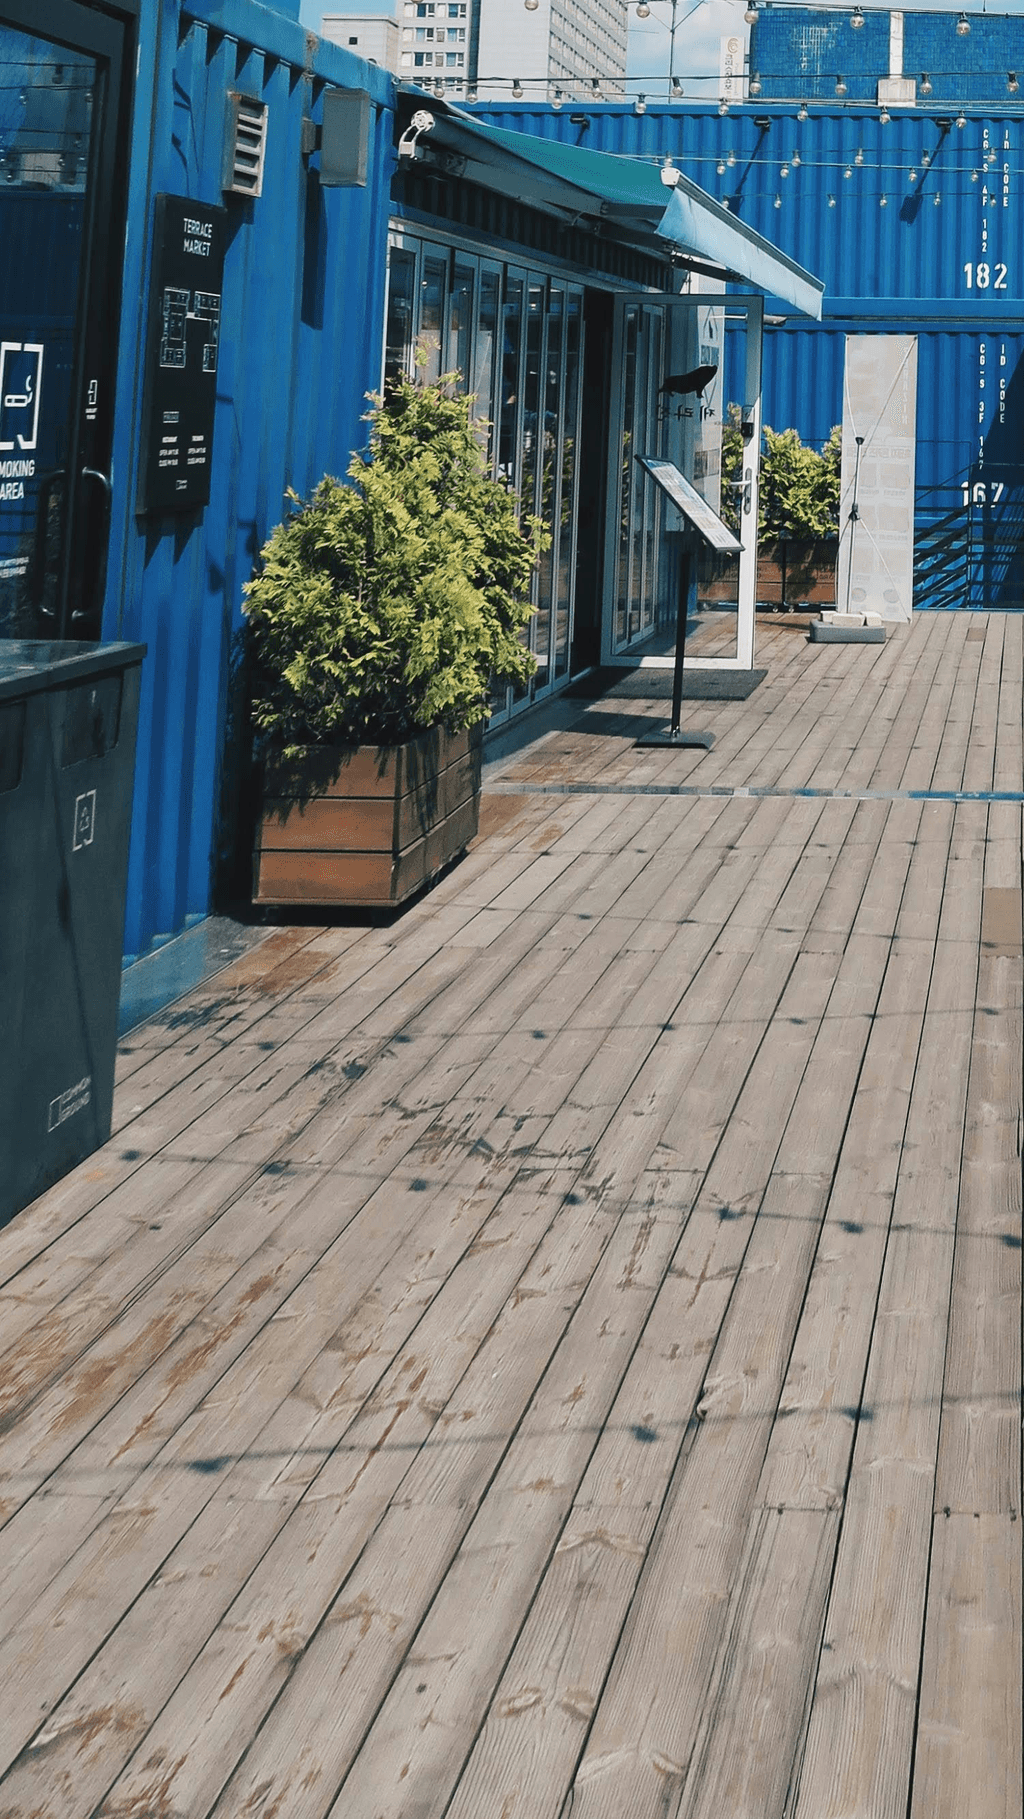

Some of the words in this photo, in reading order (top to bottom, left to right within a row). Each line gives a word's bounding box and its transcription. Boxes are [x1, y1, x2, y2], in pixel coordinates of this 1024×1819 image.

[183, 217, 213, 239] TERRACE
[183, 238, 211, 257] MARKET
[963, 262, 1008, 289] 182
[1000, 343, 1006, 366] ID
[978, 401, 985, 424] 3F
[0, 459, 35, 478] MOKING
[0, 481, 25, 501] AREA
[961, 481, 1004, 509] 167
